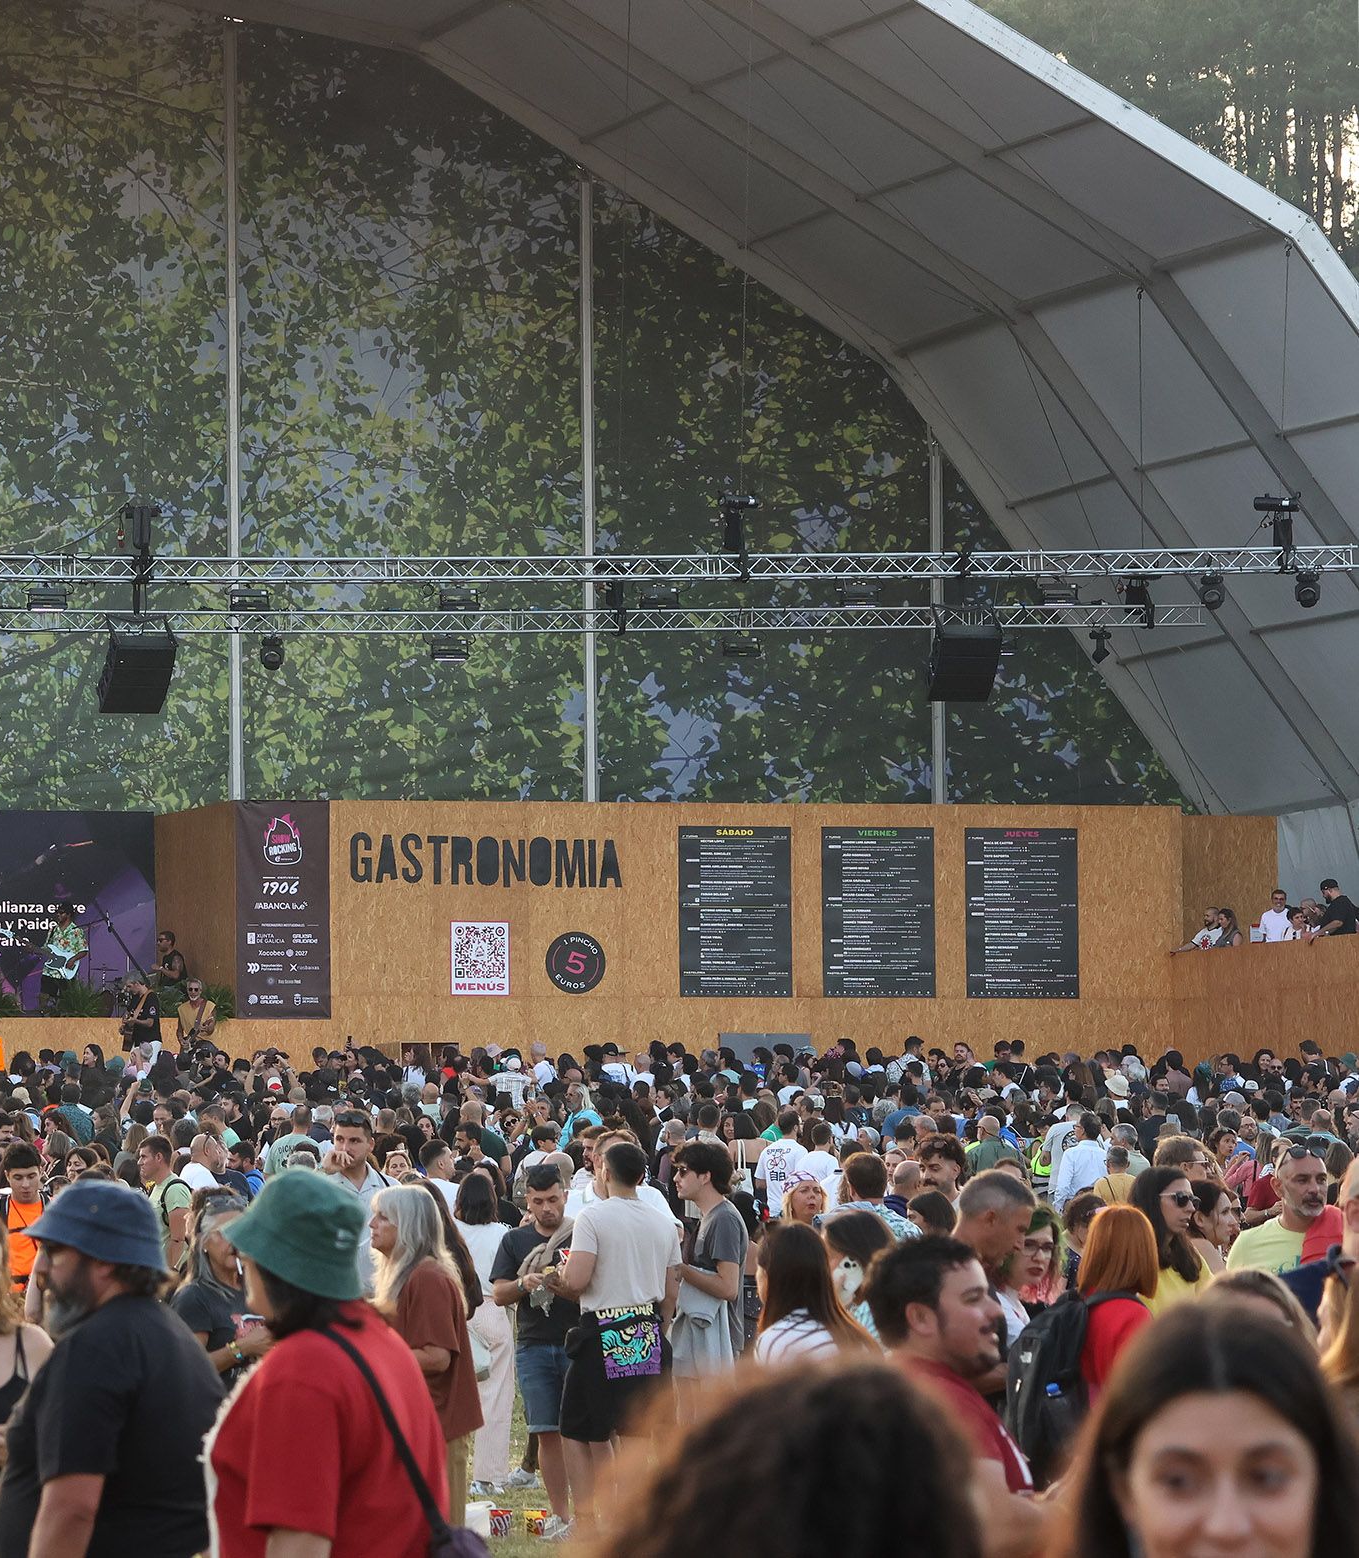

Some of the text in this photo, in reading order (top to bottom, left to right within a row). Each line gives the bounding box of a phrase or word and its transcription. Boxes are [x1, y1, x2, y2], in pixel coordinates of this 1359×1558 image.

[271, 833, 291, 844] SHOW
[716, 828, 754, 836] SÁBADO
[268, 842, 297, 856] ROCKING
[350, 831, 623, 888] GASTRONOMIA
[262, 881, 299, 895] 1906
[5, 920, 14, 931] y
[17, 918, 58, 930] Paide
[569, 936, 599, 956] PINCHO
[564, 951, 588, 975] 5
[455, 981, 506, 991] MENÚS
[554, 973, 586, 990] EUROS
